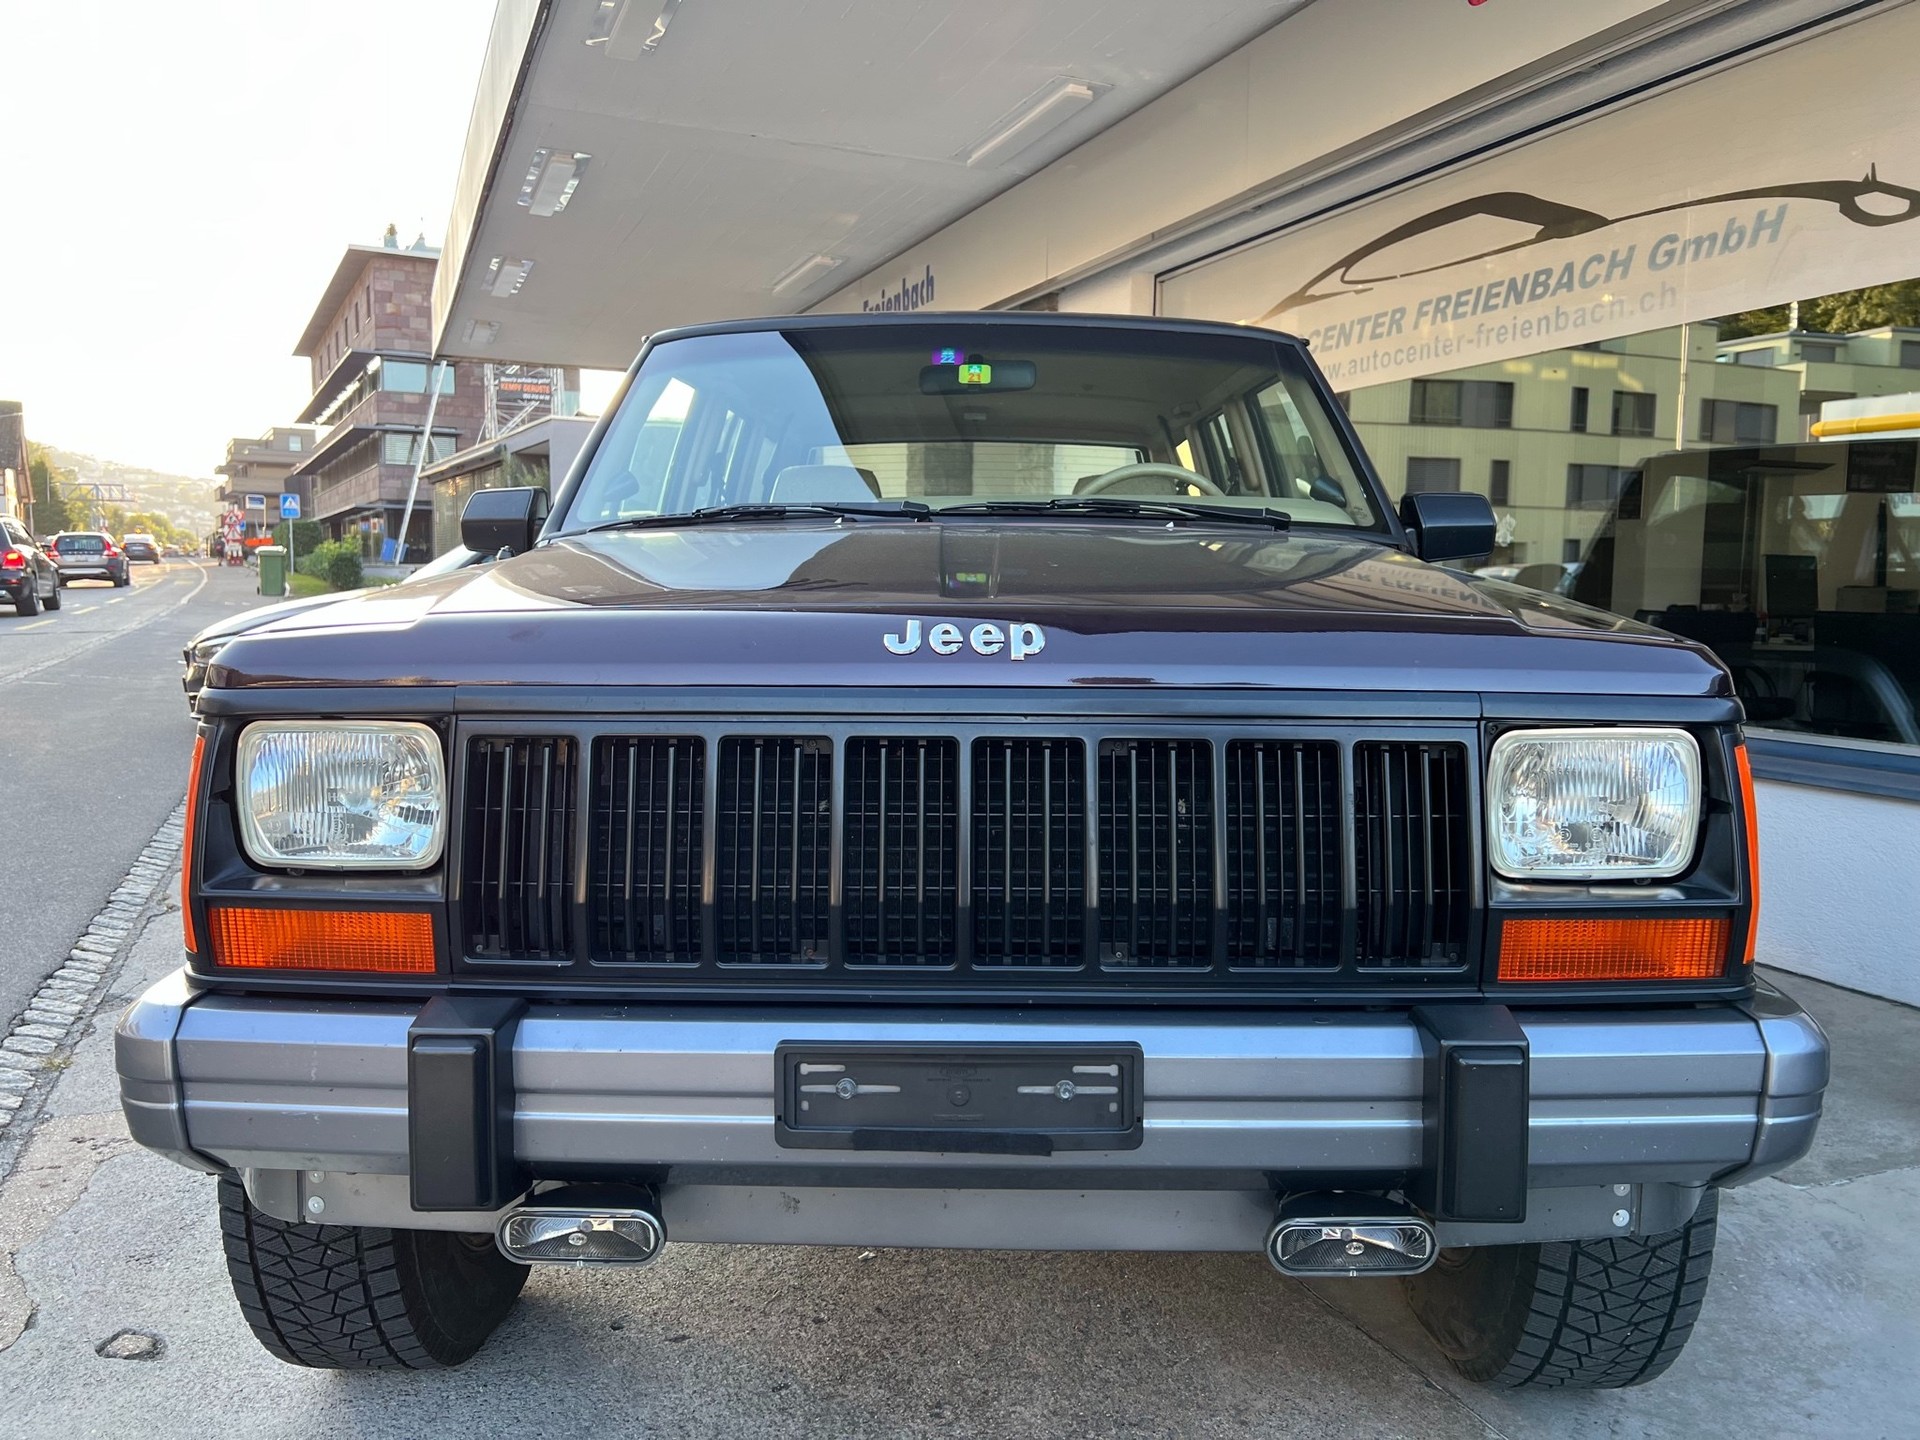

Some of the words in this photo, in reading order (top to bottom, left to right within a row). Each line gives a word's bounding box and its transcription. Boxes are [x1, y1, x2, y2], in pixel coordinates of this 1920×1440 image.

[1307, 306, 1407, 355] CENTER
[1412, 244, 1637, 330] FREIENBACH
[1647, 203, 1789, 272] GmbH
[968, 373, 982, 381] 21
[883, 619, 1046, 661] Jeep
